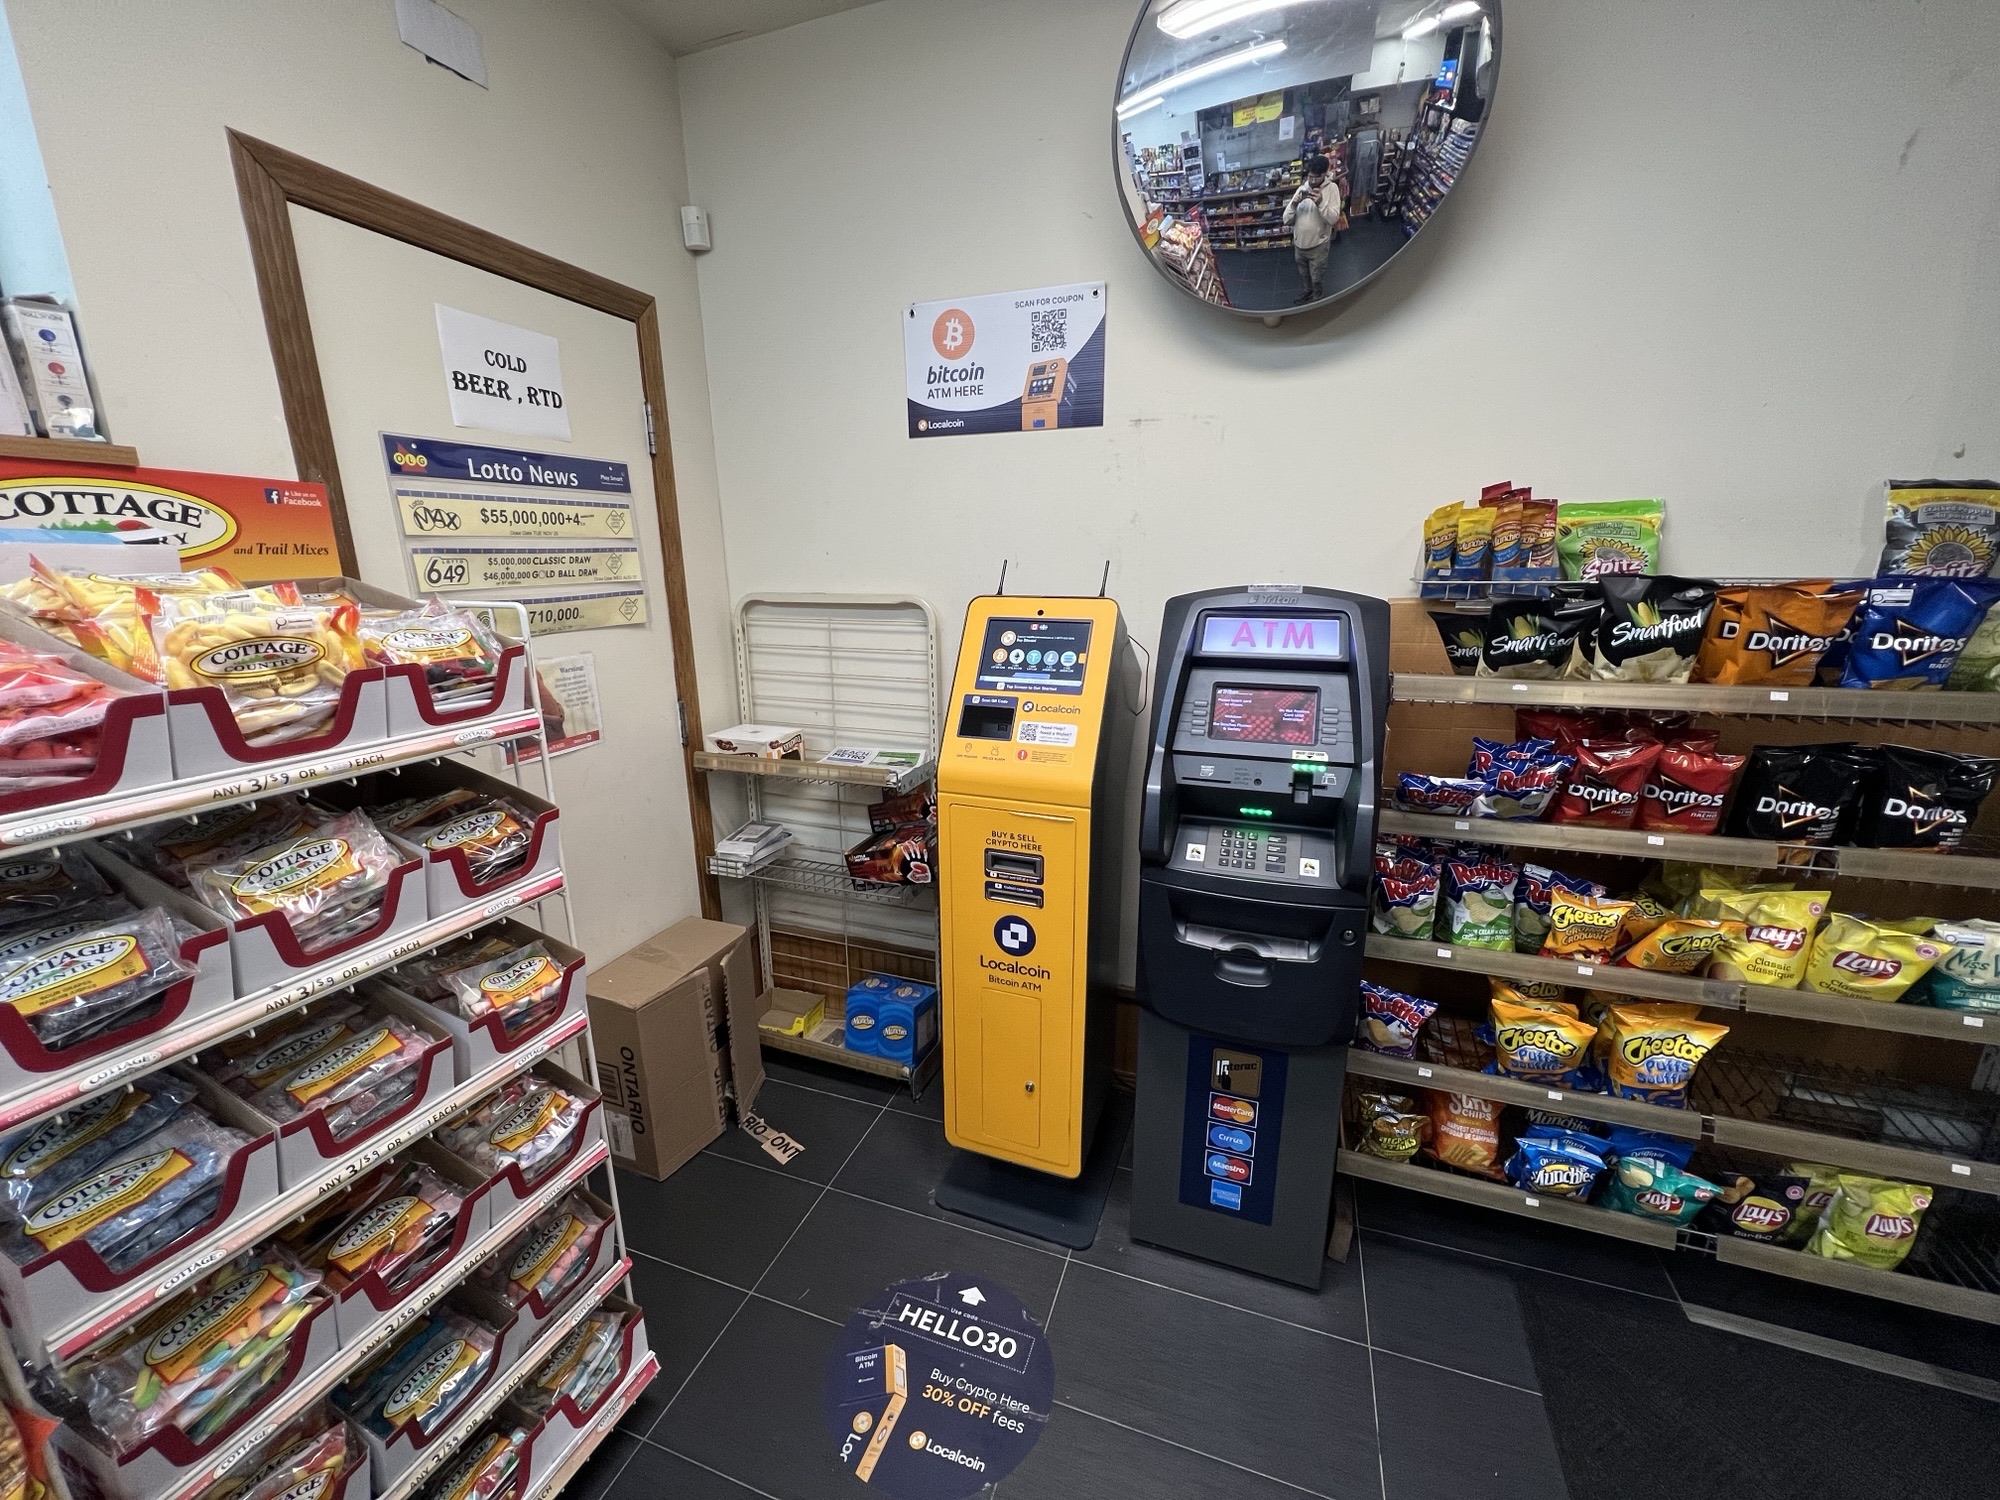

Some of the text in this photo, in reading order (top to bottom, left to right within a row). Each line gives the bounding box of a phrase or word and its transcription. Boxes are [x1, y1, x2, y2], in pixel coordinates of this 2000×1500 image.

[1015, 293, 1085, 309] SCAN FOR COUPON
[484, 349, 527, 373] COLD
[927, 362, 985, 385] bitcoin
[451, 370, 563, 409] BEER RTD
[927, 384, 984, 400] ATM HERE
[928, 418, 965, 430] Localcoin
[395, 453, 427, 467] OLG
[468, 458, 578, 487] Lotto News
[0, 490, 203, 529] COTTAGE
[283, 496, 323, 507] Facebook
[1923, 505, 1991, 514] Cracked Pepper
[413, 506, 461, 531] MAX
[234, 543, 329, 555] and Trail Mixes
[426, 559, 466, 584] 649
[488, 556, 591, 566] $5,000,000 CLASSIC DRAW
[483, 568, 598, 581] $46,000,000 GOLD BALL DRAW
[1263, 593, 1298, 605] Triton
[529, 607, 579, 624] 710,000
[1231, 621, 1315, 650] ATM
[1611, 610, 1702, 647] Smartfood
[211, 642, 308, 665] COTTAGE
[1748, 632, 1833, 652] Doritos
[1871, 632, 1967, 652] Doritos
[224, 657, 300, 673] COUNTRY
[559, 665, 585, 673] Warning:
[1035, 703, 1081, 715] Localcoin
[458, 730, 491, 743] COTTAGE
[832, 752, 866, 760] METRO
[212, 784, 242, 799] ANY
[299, 768, 318, 779] OR
[356, 753, 385, 767] EACH
[1568, 783, 1639, 805] Doritos
[1643, 783, 1724, 807] Doritos
[1756, 796, 1839, 820] Doritos
[1884, 798, 1967, 824] Doritos
[13, 818, 83, 839] COTTAGE
[991, 830, 1008, 839] BUY
[1017, 834, 1036, 843] SELL
[986, 838, 1043, 852] CRYPTO HERE
[247, 842, 333, 884] COTTAGE
[262, 856, 329, 889] COUNTRY
[487, 896, 519, 914] COTTAGE
[1552, 905, 1619, 929] Cheetos
[980, 954, 1051, 980] Localcoin
[1746, 963, 1796, 980] Classique
[1755, 957, 1792, 971] Classic
[265, 995, 291, 1014] ANY
[342, 965, 360, 979] OR
[393, 939, 421, 957] EACH
[988, 974, 1042, 992] Bitcoin ATM
[40, 980, 92, 1000] SOUR GRAPES
[1366, 992, 1427, 1030] Ruffles
[1500, 1028, 1579, 1057] Cheetos
[1623, 1032, 1709, 1064] Cheetos
[518, 1045, 546, 1066] COTTAGE
[1644, 1057, 1690, 1075] Puffs
[89, 1053, 154, 1085] COTTAGE
[619, 1046, 645, 1135] ONTARIO
[497, 1096, 548, 1136] COTTAGE
[1213, 1102, 1254, 1117] MasterCard
[1461, 1108, 1492, 1121] CHIPS
[1526, 1109, 1591, 1132] Munchies
[743, 1115, 768, 1137] RIO
[318, 1174, 342, 1197] ANY
[387, 1137, 403, 1152] OR
[433, 1103, 458, 1125] EACH
[770, 1136, 800, 1159] ONT
[1218, 1133, 1244, 1146] Cirrus
[1212, 1160, 1246, 1174] Maestro
[1531, 1166, 1596, 1186] Munchies
[43, 1156, 158, 1219] COTTAGE
[543, 1181, 568, 1204] COTTAGE
[1740, 1203, 1788, 1226] Lay's
[1868, 1215, 1915, 1239] Lay's
[514, 1219, 564, 1269] COTTAGE
[527, 1229, 566, 1269] COUNTRY
[162, 1253, 217, 1292] COTTAGE
[159, 1277, 253, 1348] COTTAGE
[359, 1337, 385, 1360] ANY
[421, 1291, 437, 1306] OR
[465, 1250, 487, 1273] EACH
[573, 1297, 599, 1322] COTTAGE
[950, 1307, 979, 1321] Use code
[176, 1289, 248, 1347] COUNTRY
[898, 1303, 1017, 1359] HELLO30
[855, 1352, 878, 1362] Bitcoin
[859, 1361, 874, 1370] ATM
[393, 1346, 455, 1404] COTTAGE
[406, 1356, 453, 1403] COUNTRY
[930, 1368, 1031, 1414] Buy Crypto Here
[922, 1384, 1025, 1434] 30% OFF fees
[410, 1466, 431, 1492] ANY
[465, 1418, 479, 1433] OR
[502, 1372, 525, 1395] EACH
[220, 1429, 272, 1470] COTTAGE
[925, 1438, 986, 1473] Localcoin
